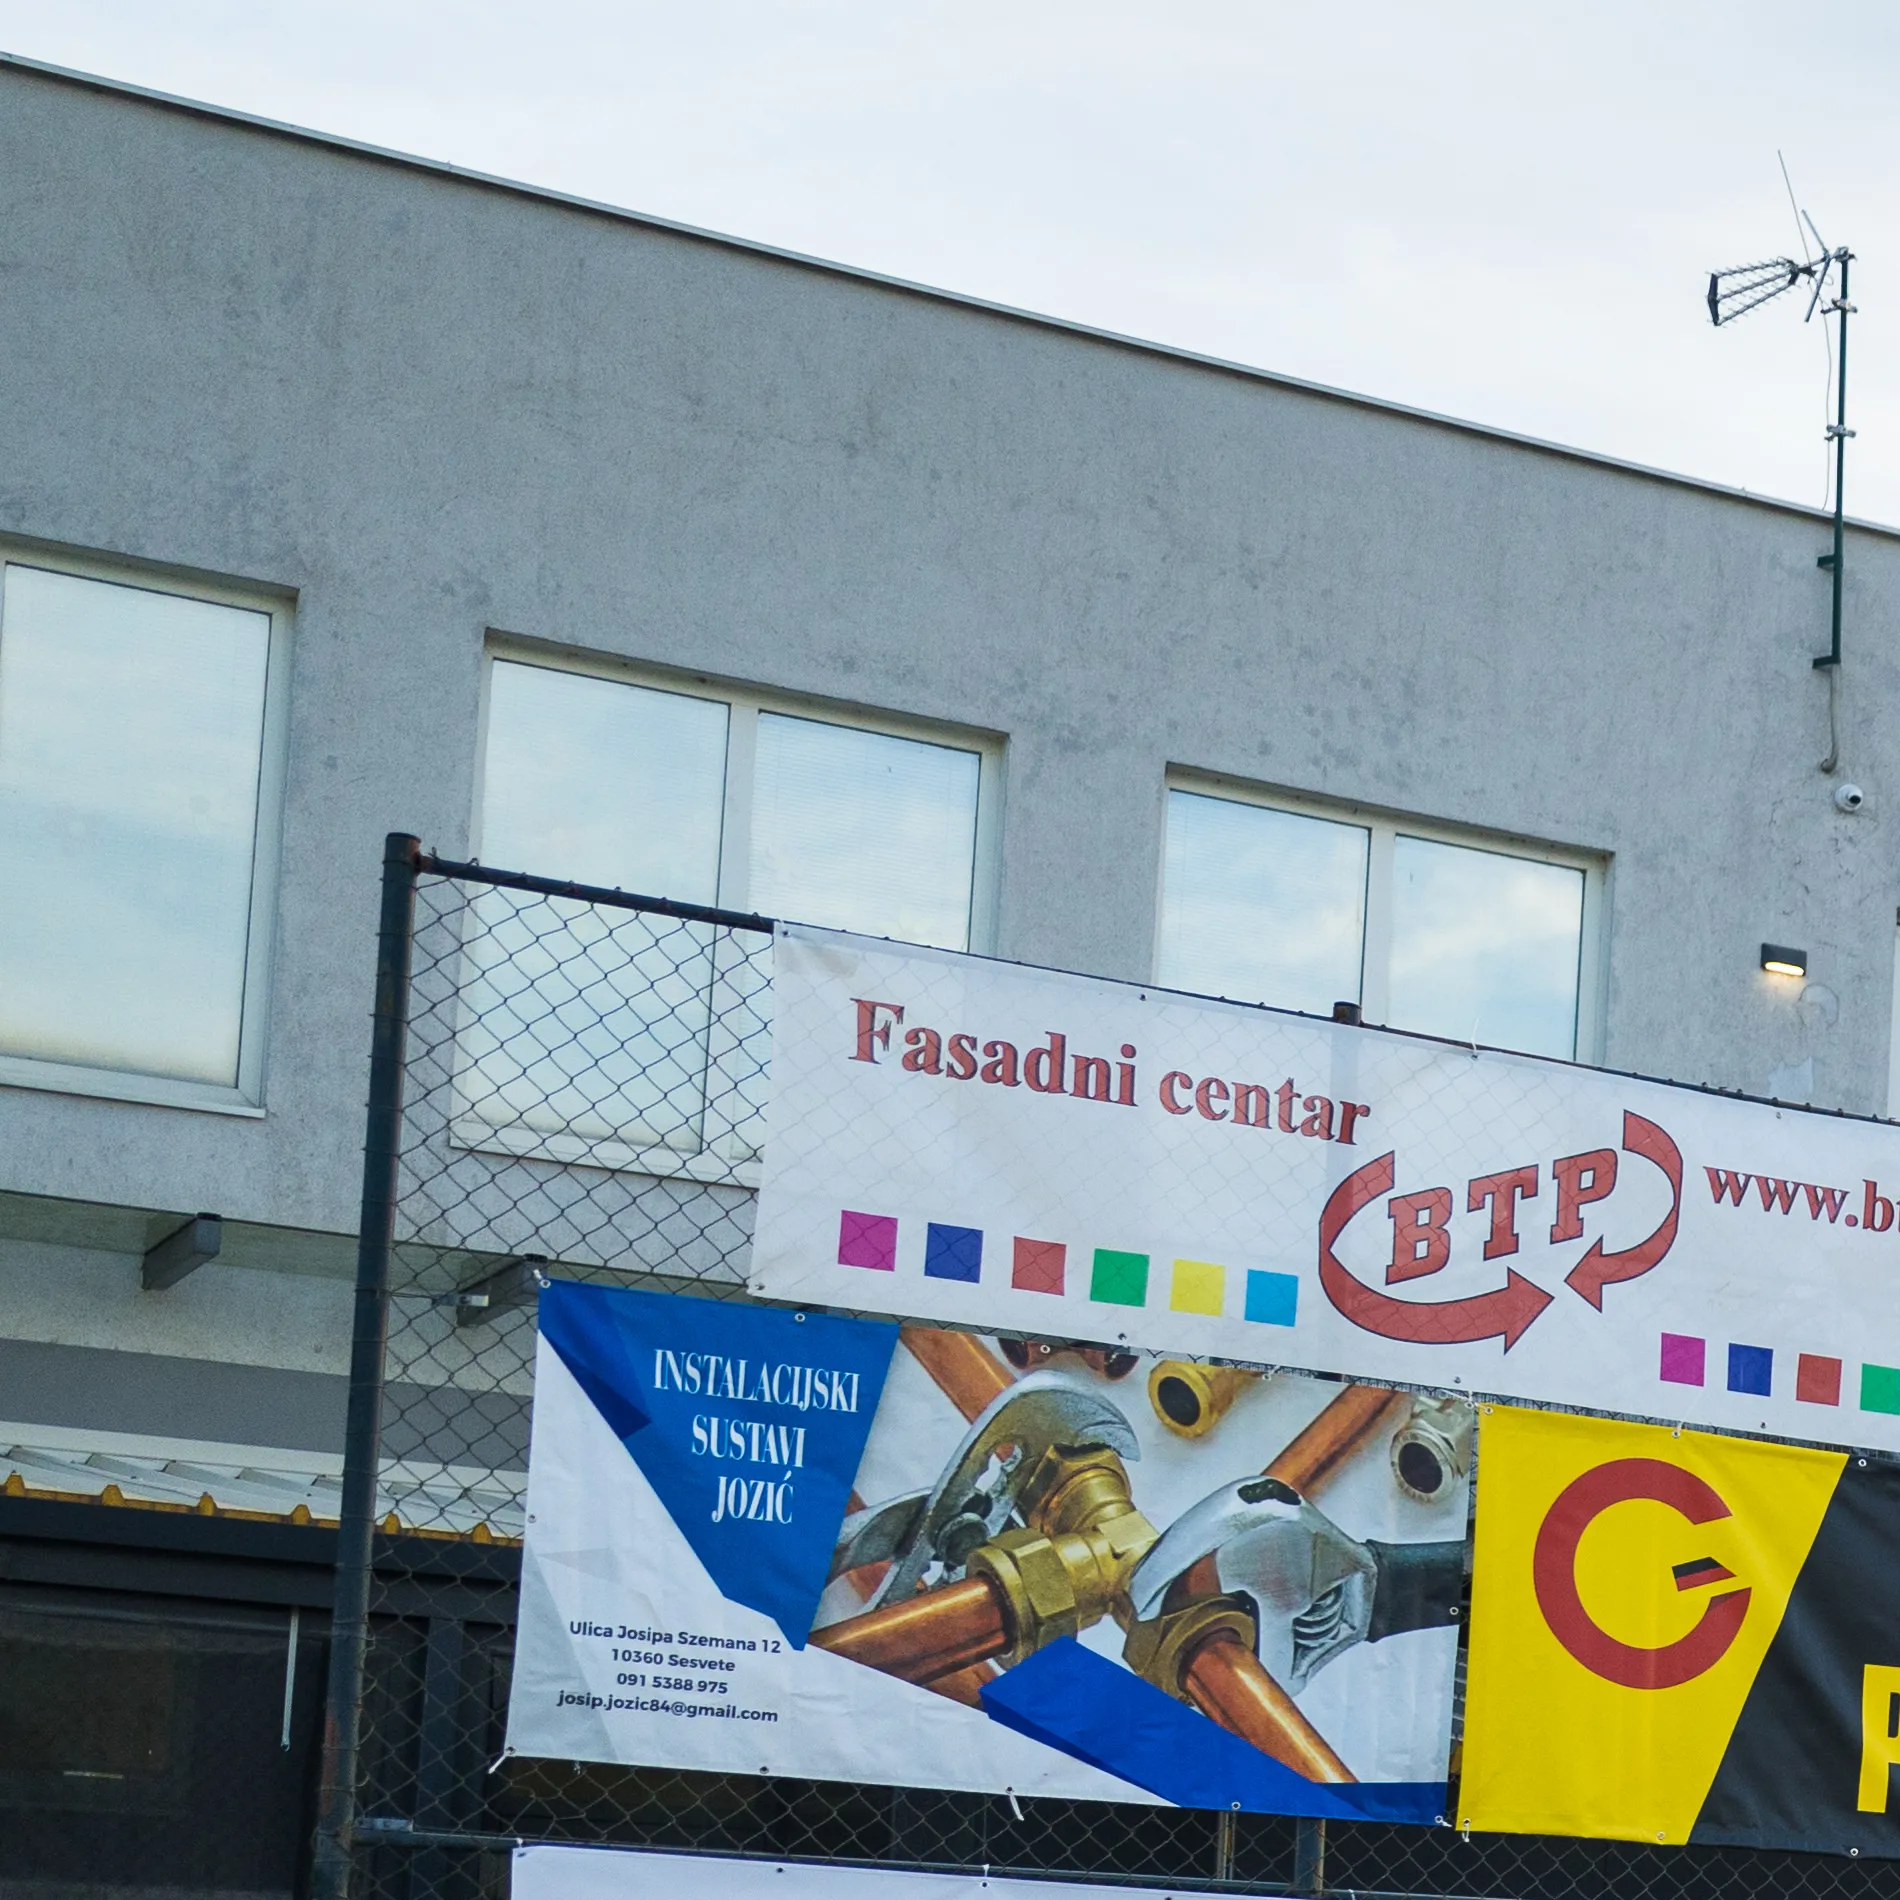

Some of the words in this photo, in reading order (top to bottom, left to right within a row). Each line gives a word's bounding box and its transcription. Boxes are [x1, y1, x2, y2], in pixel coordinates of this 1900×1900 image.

[848, 997, 1139, 1106] Fasadni
[1160, 1071, 1370, 1145] centar
[1385, 1148, 1617, 1286] BTP
[653, 1348, 860, 1413] INSTALACIJSKI
[692, 1414, 806, 1468] SUSTAVI
[712, 1472, 793, 1524] JOZIĆ
[569, 1620, 614, 1639] Ulica
[617, 1624, 673, 1646] Josipa
[677, 1630, 757, 1652] Szemana
[761, 1637, 781, 1654] 12
[611, 1647, 664, 1666] 10360
[667, 1653, 736, 1673] Sesvete
[556, 1688, 779, 1723] josip.jozic84@gmail.com
[616, 1672, 648, 1688] 091
[652, 1674, 694, 1692] 5388
[697, 1678, 729, 1695] 975
